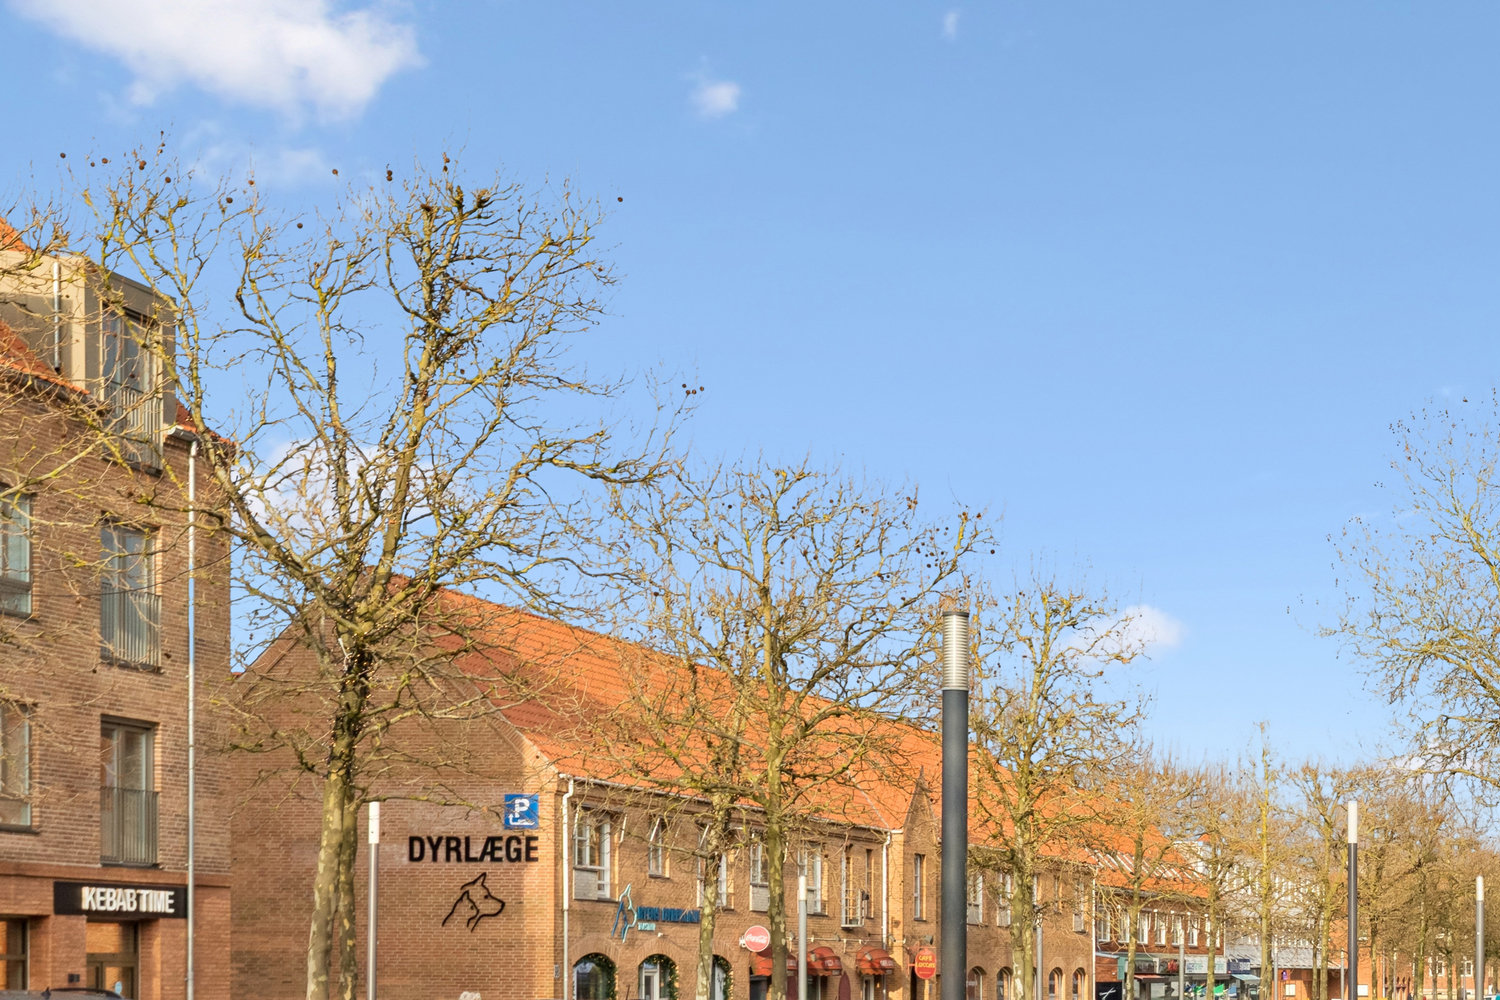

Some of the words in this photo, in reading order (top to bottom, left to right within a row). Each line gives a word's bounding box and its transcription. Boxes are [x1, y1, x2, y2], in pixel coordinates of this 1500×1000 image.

[515, 798, 530, 818] P
[408, 835, 539, 863] DYRLÆGE
[81, 886, 137, 911] KEBAB
[136, 889, 175, 913] TIME
